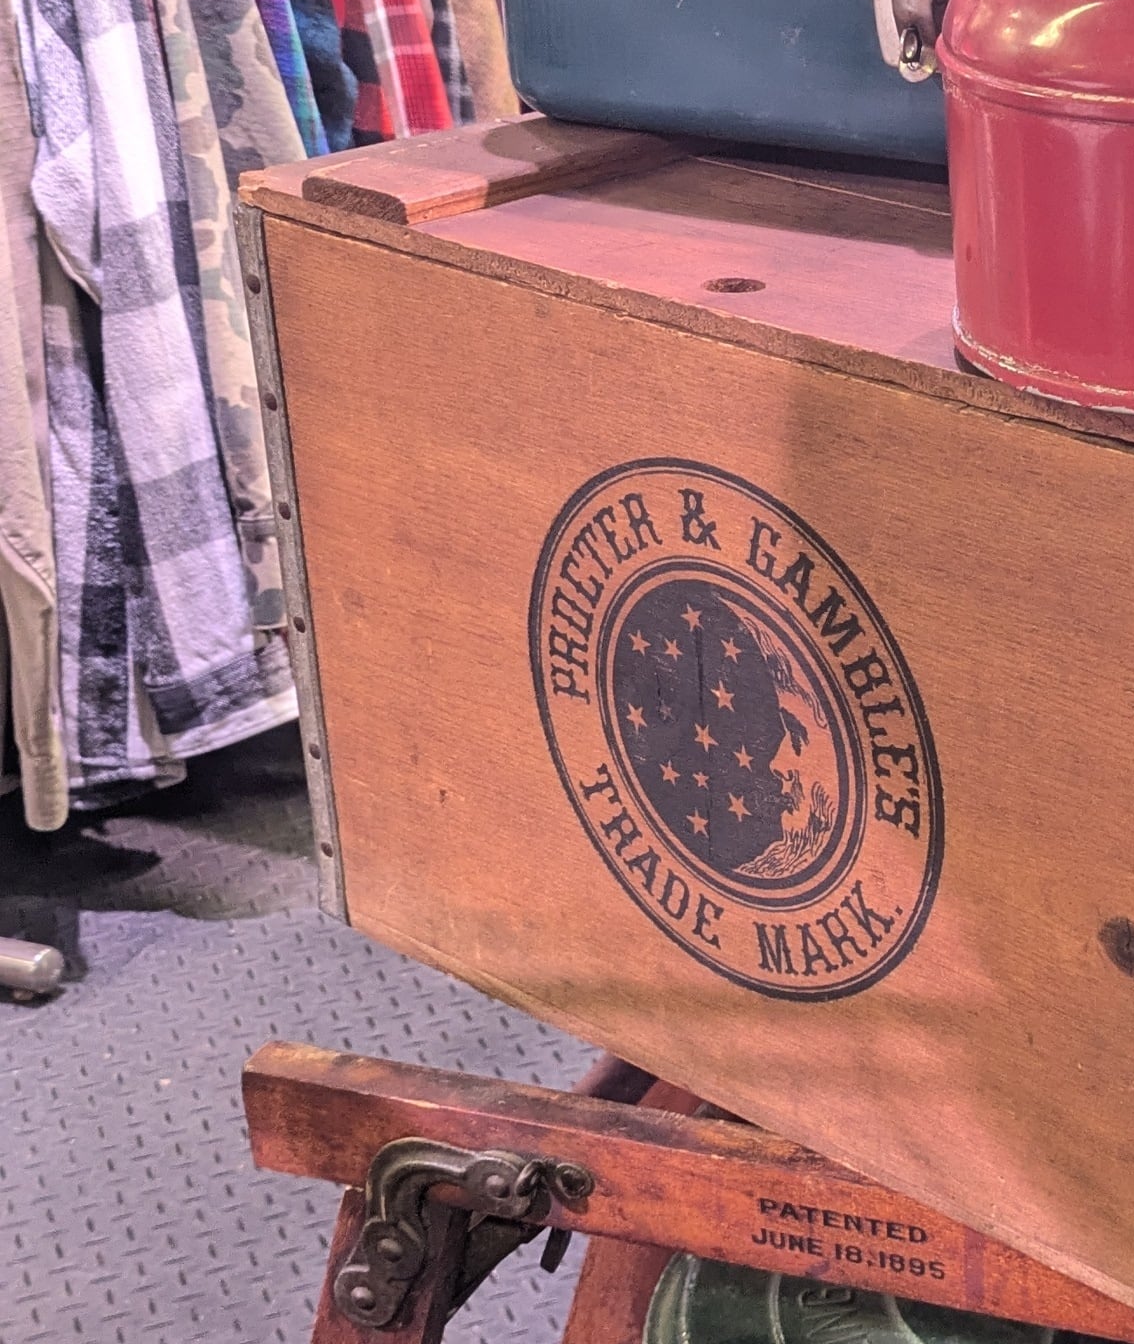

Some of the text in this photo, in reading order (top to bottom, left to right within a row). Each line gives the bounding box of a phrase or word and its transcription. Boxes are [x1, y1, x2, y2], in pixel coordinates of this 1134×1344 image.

[550, 491, 663, 704] PROCTER
[680, 488, 722, 551] &
[579, 762, 724, 951] TRADE
[751, 1227, 823, 1257] JUNE
[757, 1197, 928, 1244] PATENTED
